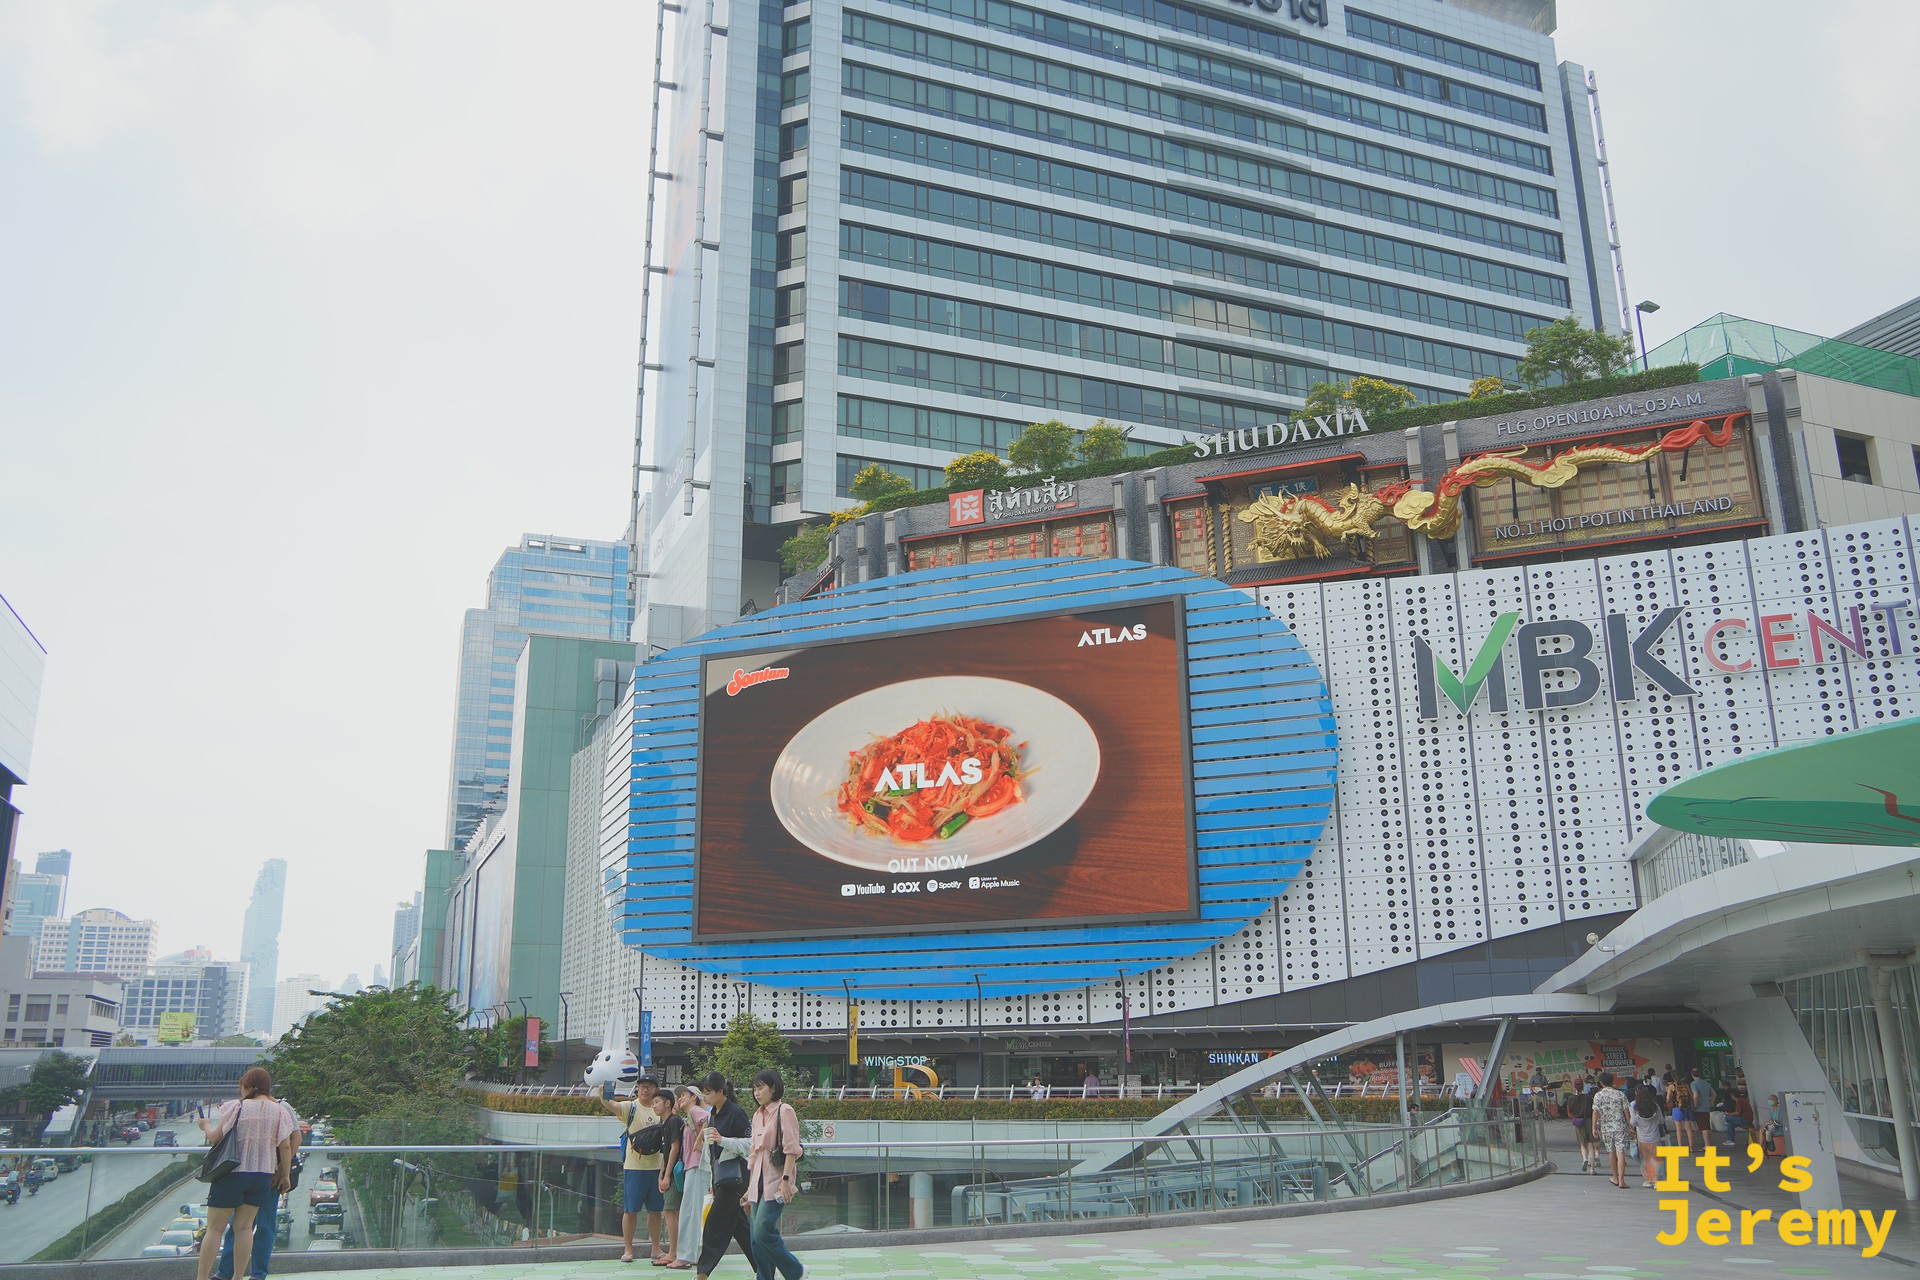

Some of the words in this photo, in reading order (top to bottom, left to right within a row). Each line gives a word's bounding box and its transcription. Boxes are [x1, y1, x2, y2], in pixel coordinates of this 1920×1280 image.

[1540, 517, 1577, 533] HOT
[1579, 511, 1613, 528] POT
[1617, 509, 1635, 523] IN
[1640, 496, 1731, 520] THAILAND
[1077, 623, 1147, 647] ATLAS
[1413, 605, 1700, 721] MBK
[1702, 599, 1908, 673] CENT
[726, 666, 790, 696] Somtam
[873, 757, 983, 792] ATLAS
[887, 858, 919, 873] OUT
[925, 854, 968, 871] NOW
[857, 883, 886, 895] YouTube
[891, 881, 920, 893] JOOX
[938, 880, 962, 890] Spotify
[981, 880, 1000, 889] Apple
[1534, 1048, 1579, 1065] MBK
[1541, 1063, 1585, 1075] ENTER
[1702, 1057, 1711, 1081] EXCH
